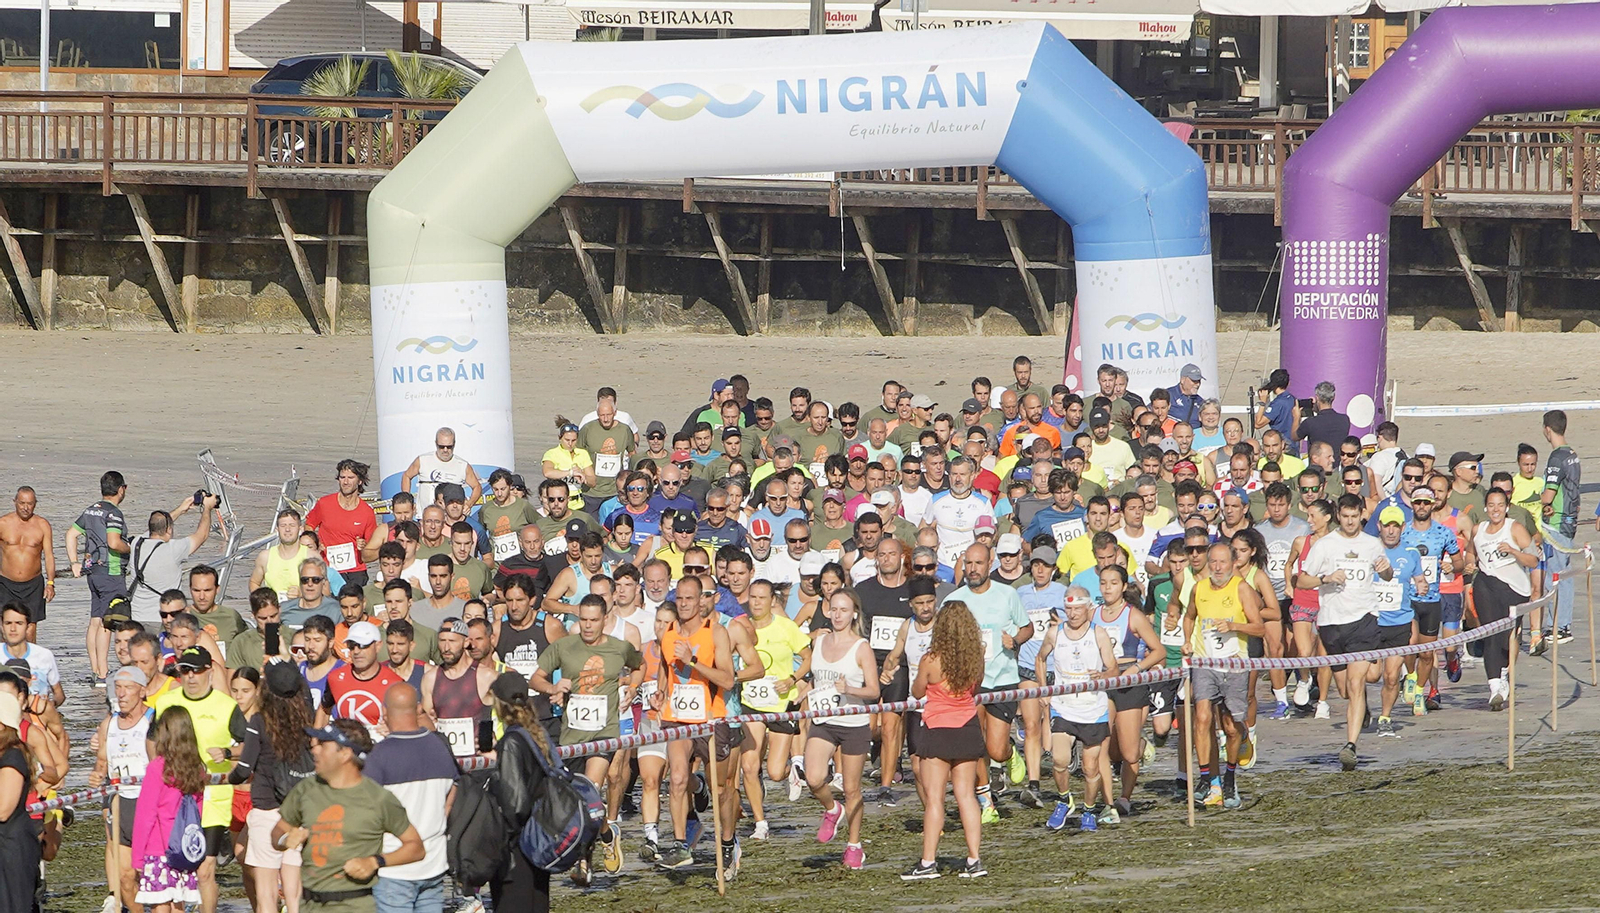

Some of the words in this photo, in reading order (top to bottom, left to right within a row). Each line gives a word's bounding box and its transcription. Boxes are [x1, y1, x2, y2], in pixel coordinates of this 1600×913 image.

[581, 10, 631, 24] Mesón
[638, 10, 734, 25] BEIRAMAR
[1139, 22, 1177, 33] Mahou
[776, 64, 988, 115] NIGRÁN
[849, 123, 921, 140] Equilibrio
[925, 119, 986, 135] Natural
[1293, 288, 1379, 306] DEPUTACIÓN
[1293, 306, 1380, 320] PONTEVEDRA
[1101, 335, 1194, 361] NIGRÁN
[392, 358, 485, 385] NIGRÁN
[404, 390, 443, 401] Equilibrio
[445, 388, 478, 399] Natural
[601, 462, 616, 471] 47
[1056, 527, 1082, 544] 180
[330, 552, 351, 565] 157
[1375, 592, 1394, 604] 35
[1214, 636, 1225, 650] 3
[748, 685, 769, 699] 38
[673, 697, 700, 711] 166
[572, 707, 600, 722] 121
